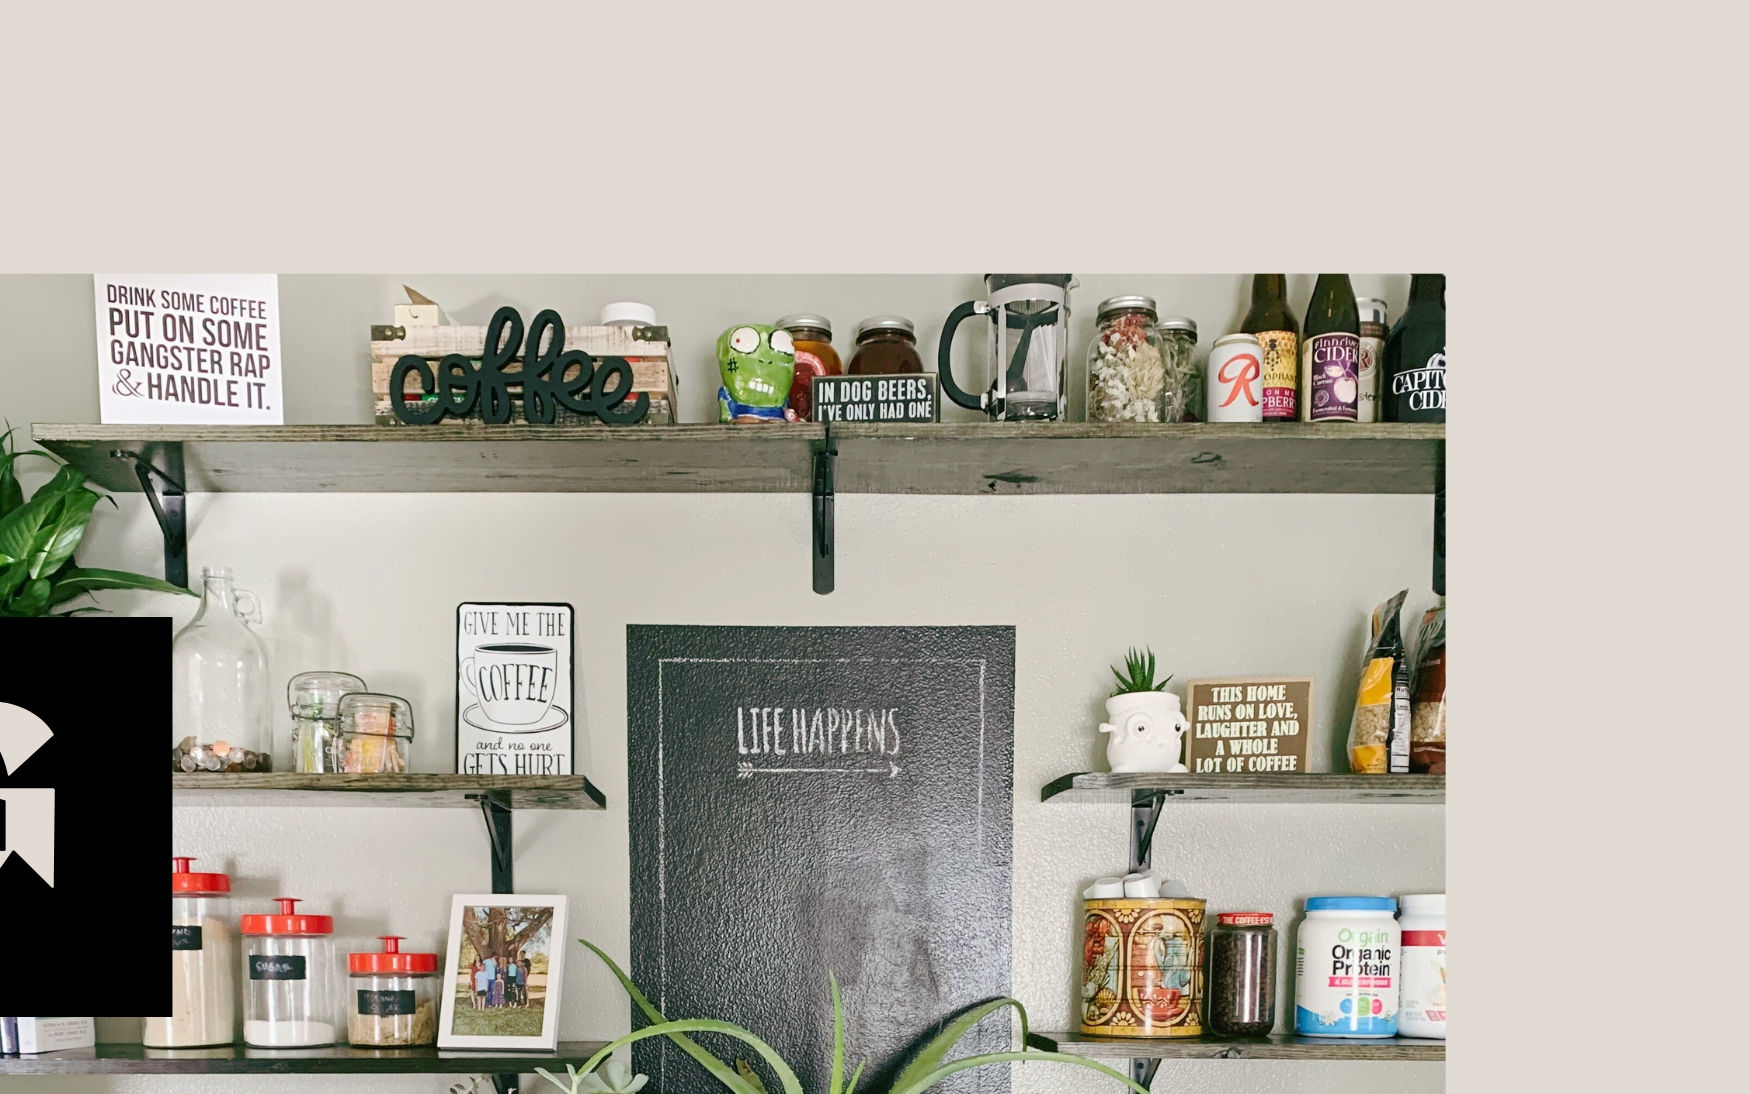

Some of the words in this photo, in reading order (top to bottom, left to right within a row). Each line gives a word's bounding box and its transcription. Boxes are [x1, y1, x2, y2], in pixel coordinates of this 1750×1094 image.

[107, 284, 156, 308] DRINK
[161, 290, 205, 313] SOME
[210, 296, 267, 320] COFFEE
[109, 307, 154, 339] PUT
[162, 313, 194, 344] ON
[202, 317, 268, 352] SOME
[111, 339, 223, 375] GANGSTER
[230, 351, 271, 379] RAP
[390, 306, 649, 425] coffee
[1314, 346, 1359, 364] CIDER
[112, 368, 145, 398] &
[147, 372, 239, 408] HANDLE
[246, 382, 271, 410] IT.
[819, 382, 835, 403] IN
[840, 381, 872, 402] DOG
[878, 379, 932, 401] BEERS,
[1218, 353, 1260, 408] R
[1392, 370, 1446, 395] CAPIT
[846, 403, 875, 421] ONLY
[880, 402, 904, 419] HAD
[908, 401, 932, 418] ONE
[464, 611, 499, 635] GIVE
[506, 612, 530, 636] ME
[536, 612, 565, 636] THE
[479, 663, 553, 703] COFFEE
[1211, 686, 1242, 703] THIS
[1246, 685, 1286, 701] HOME
[1198, 705, 1232, 721] RUNS
[1235, 704, 1254, 719] ON
[1258, 703, 1298, 719] LOVE,
[738, 707, 787, 755] LIFE
[792, 707, 900, 755] HAPPENS
[1196, 721, 1268, 738] LAUGHTER
[1271, 720, 1299, 736] AND
[476, 737, 504, 751] and
[508, 743, 526, 751] no
[530, 743, 553, 751] one
[1216, 740, 1225, 756] A
[1229, 738, 1278, 755] WHOLE
[1196, 758, 1222, 773] LOT
[1226, 757, 1244, 773] OF
[1248, 756, 1297, 771] COFFEE
[1332, 944, 1391, 963] Organic
[1332, 961, 1390, 976] Protein
